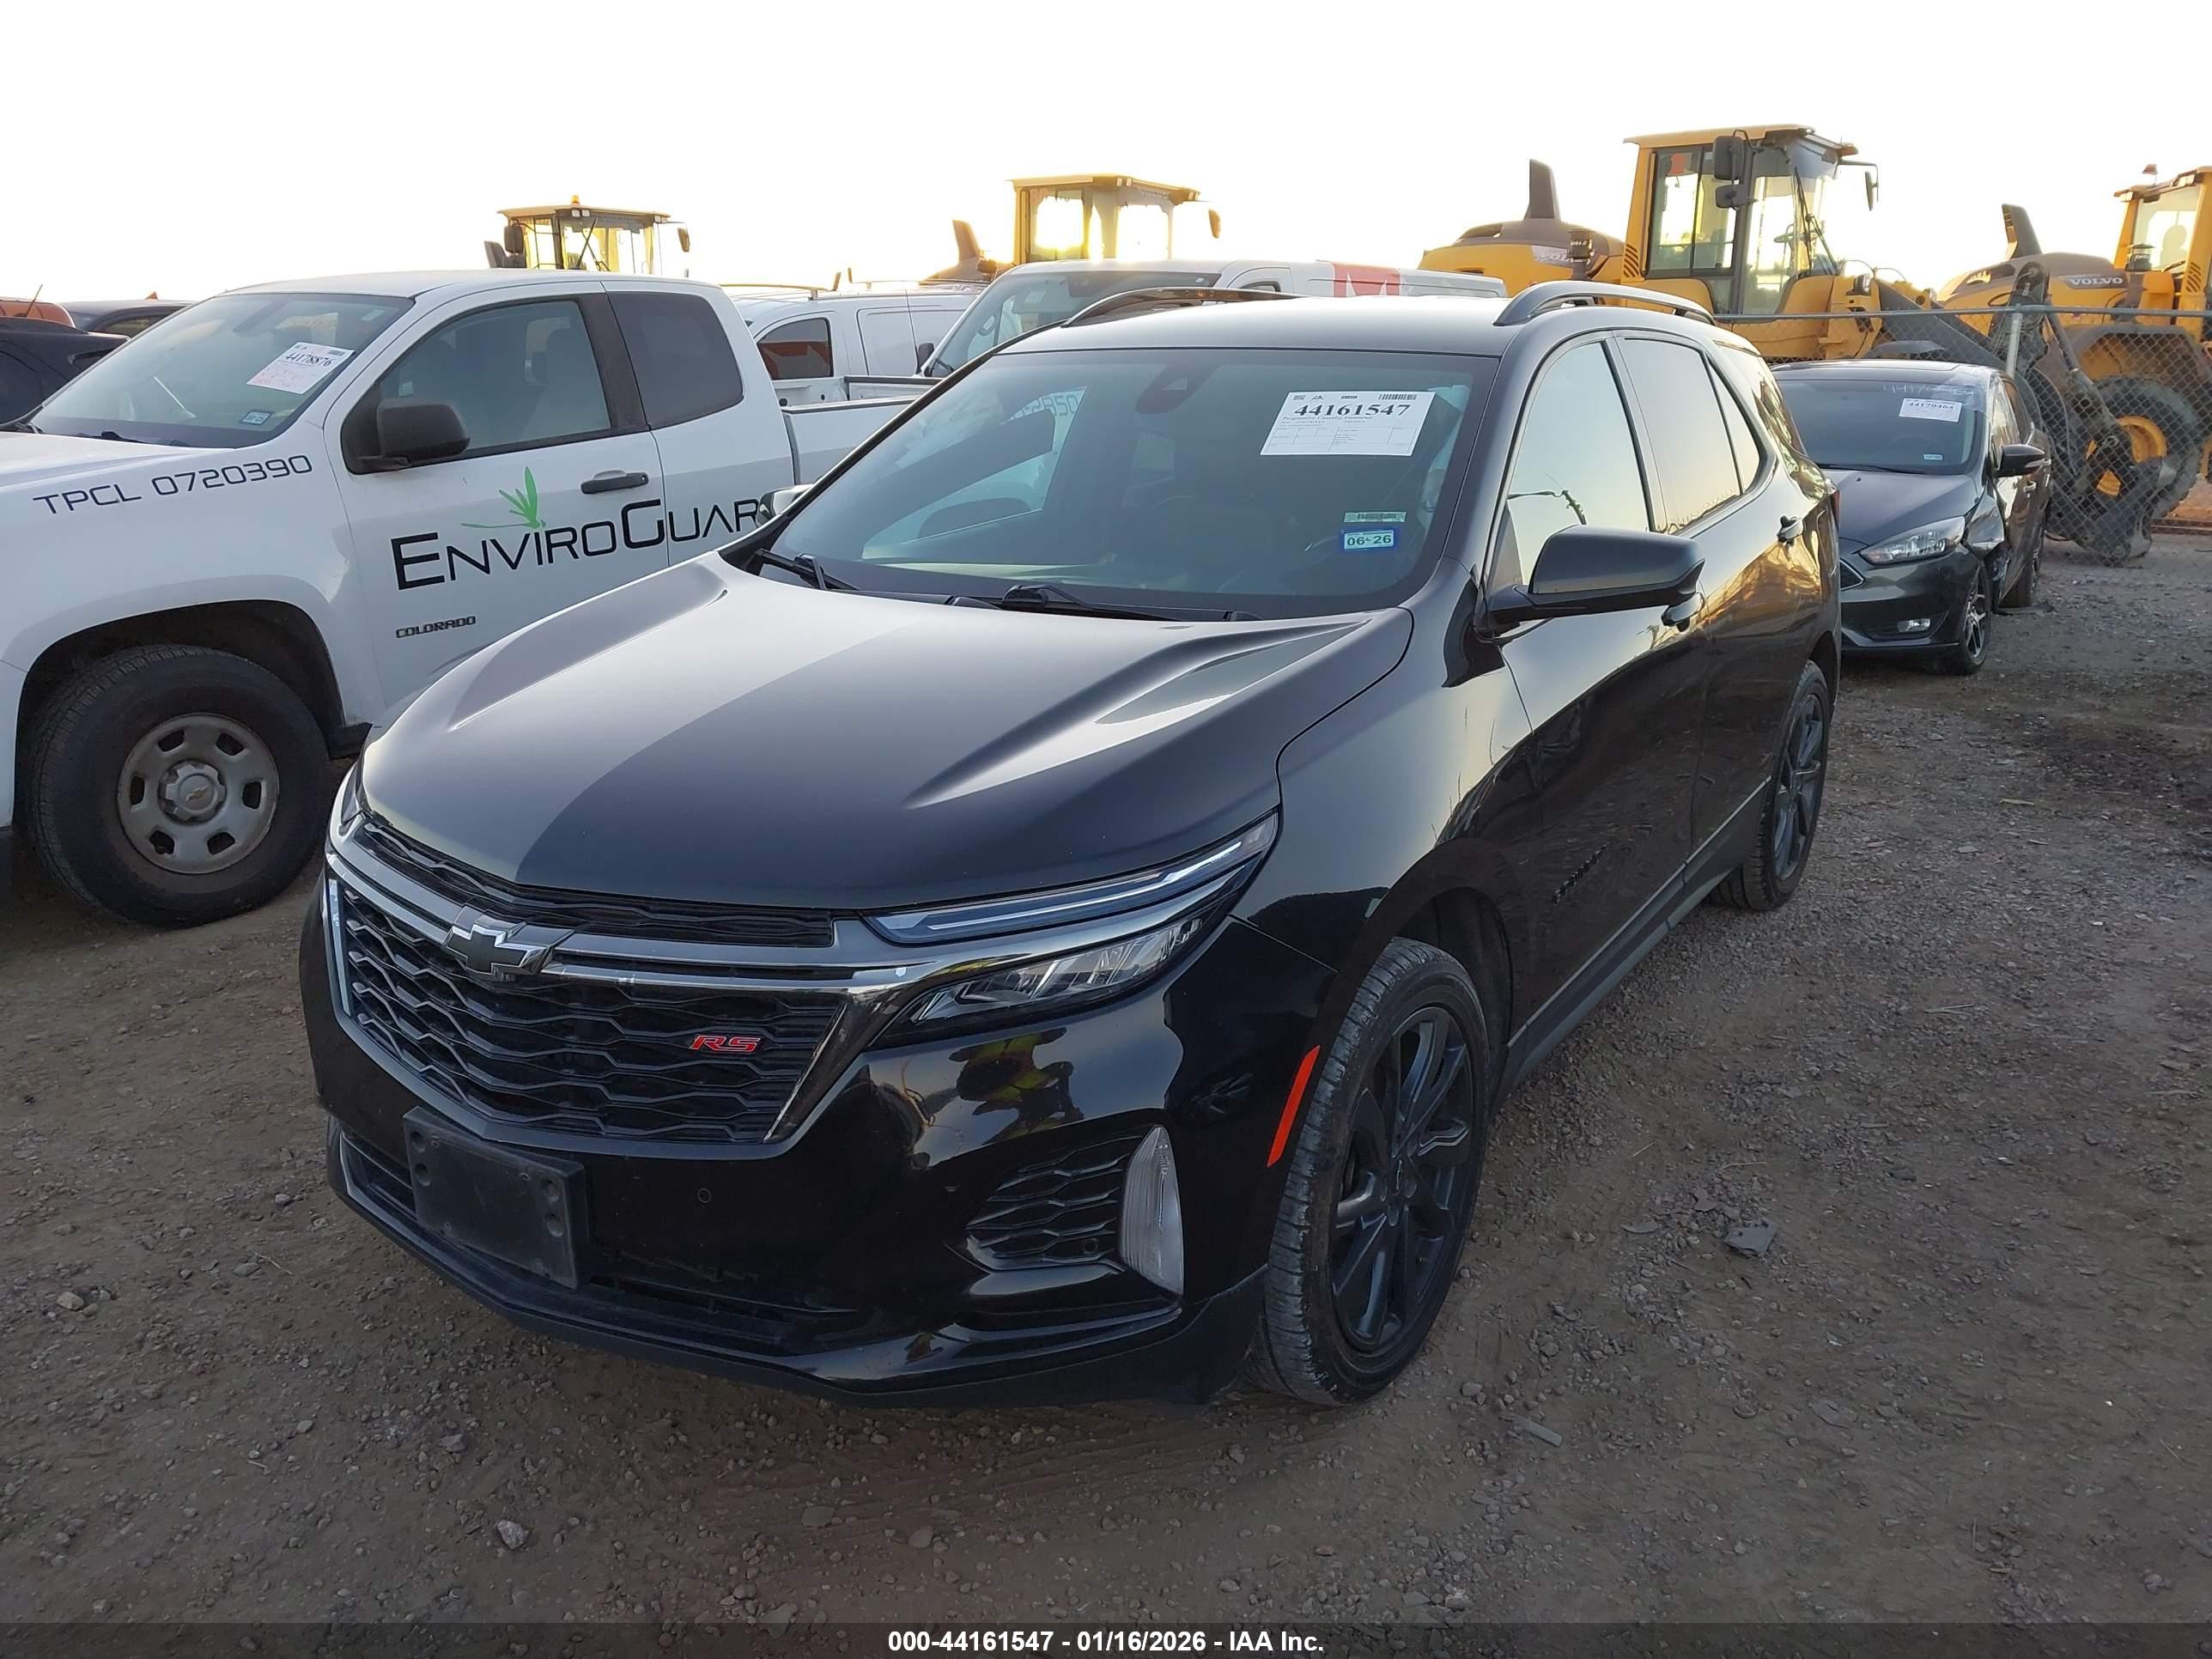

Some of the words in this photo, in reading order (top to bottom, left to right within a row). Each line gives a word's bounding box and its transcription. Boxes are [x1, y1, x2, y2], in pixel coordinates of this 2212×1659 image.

[2069, 276, 2124, 285] VOLVO
[1294, 404, 1413, 416] 44161547
[33, 483, 142, 514] TPCL
[151, 454, 313, 495] 0720390
[1346, 537, 1365, 546] 06
[1373, 534, 1392, 544] 26
[395, 616, 476, 638] COLORADO
[690, 1035, 761, 1053] RS
